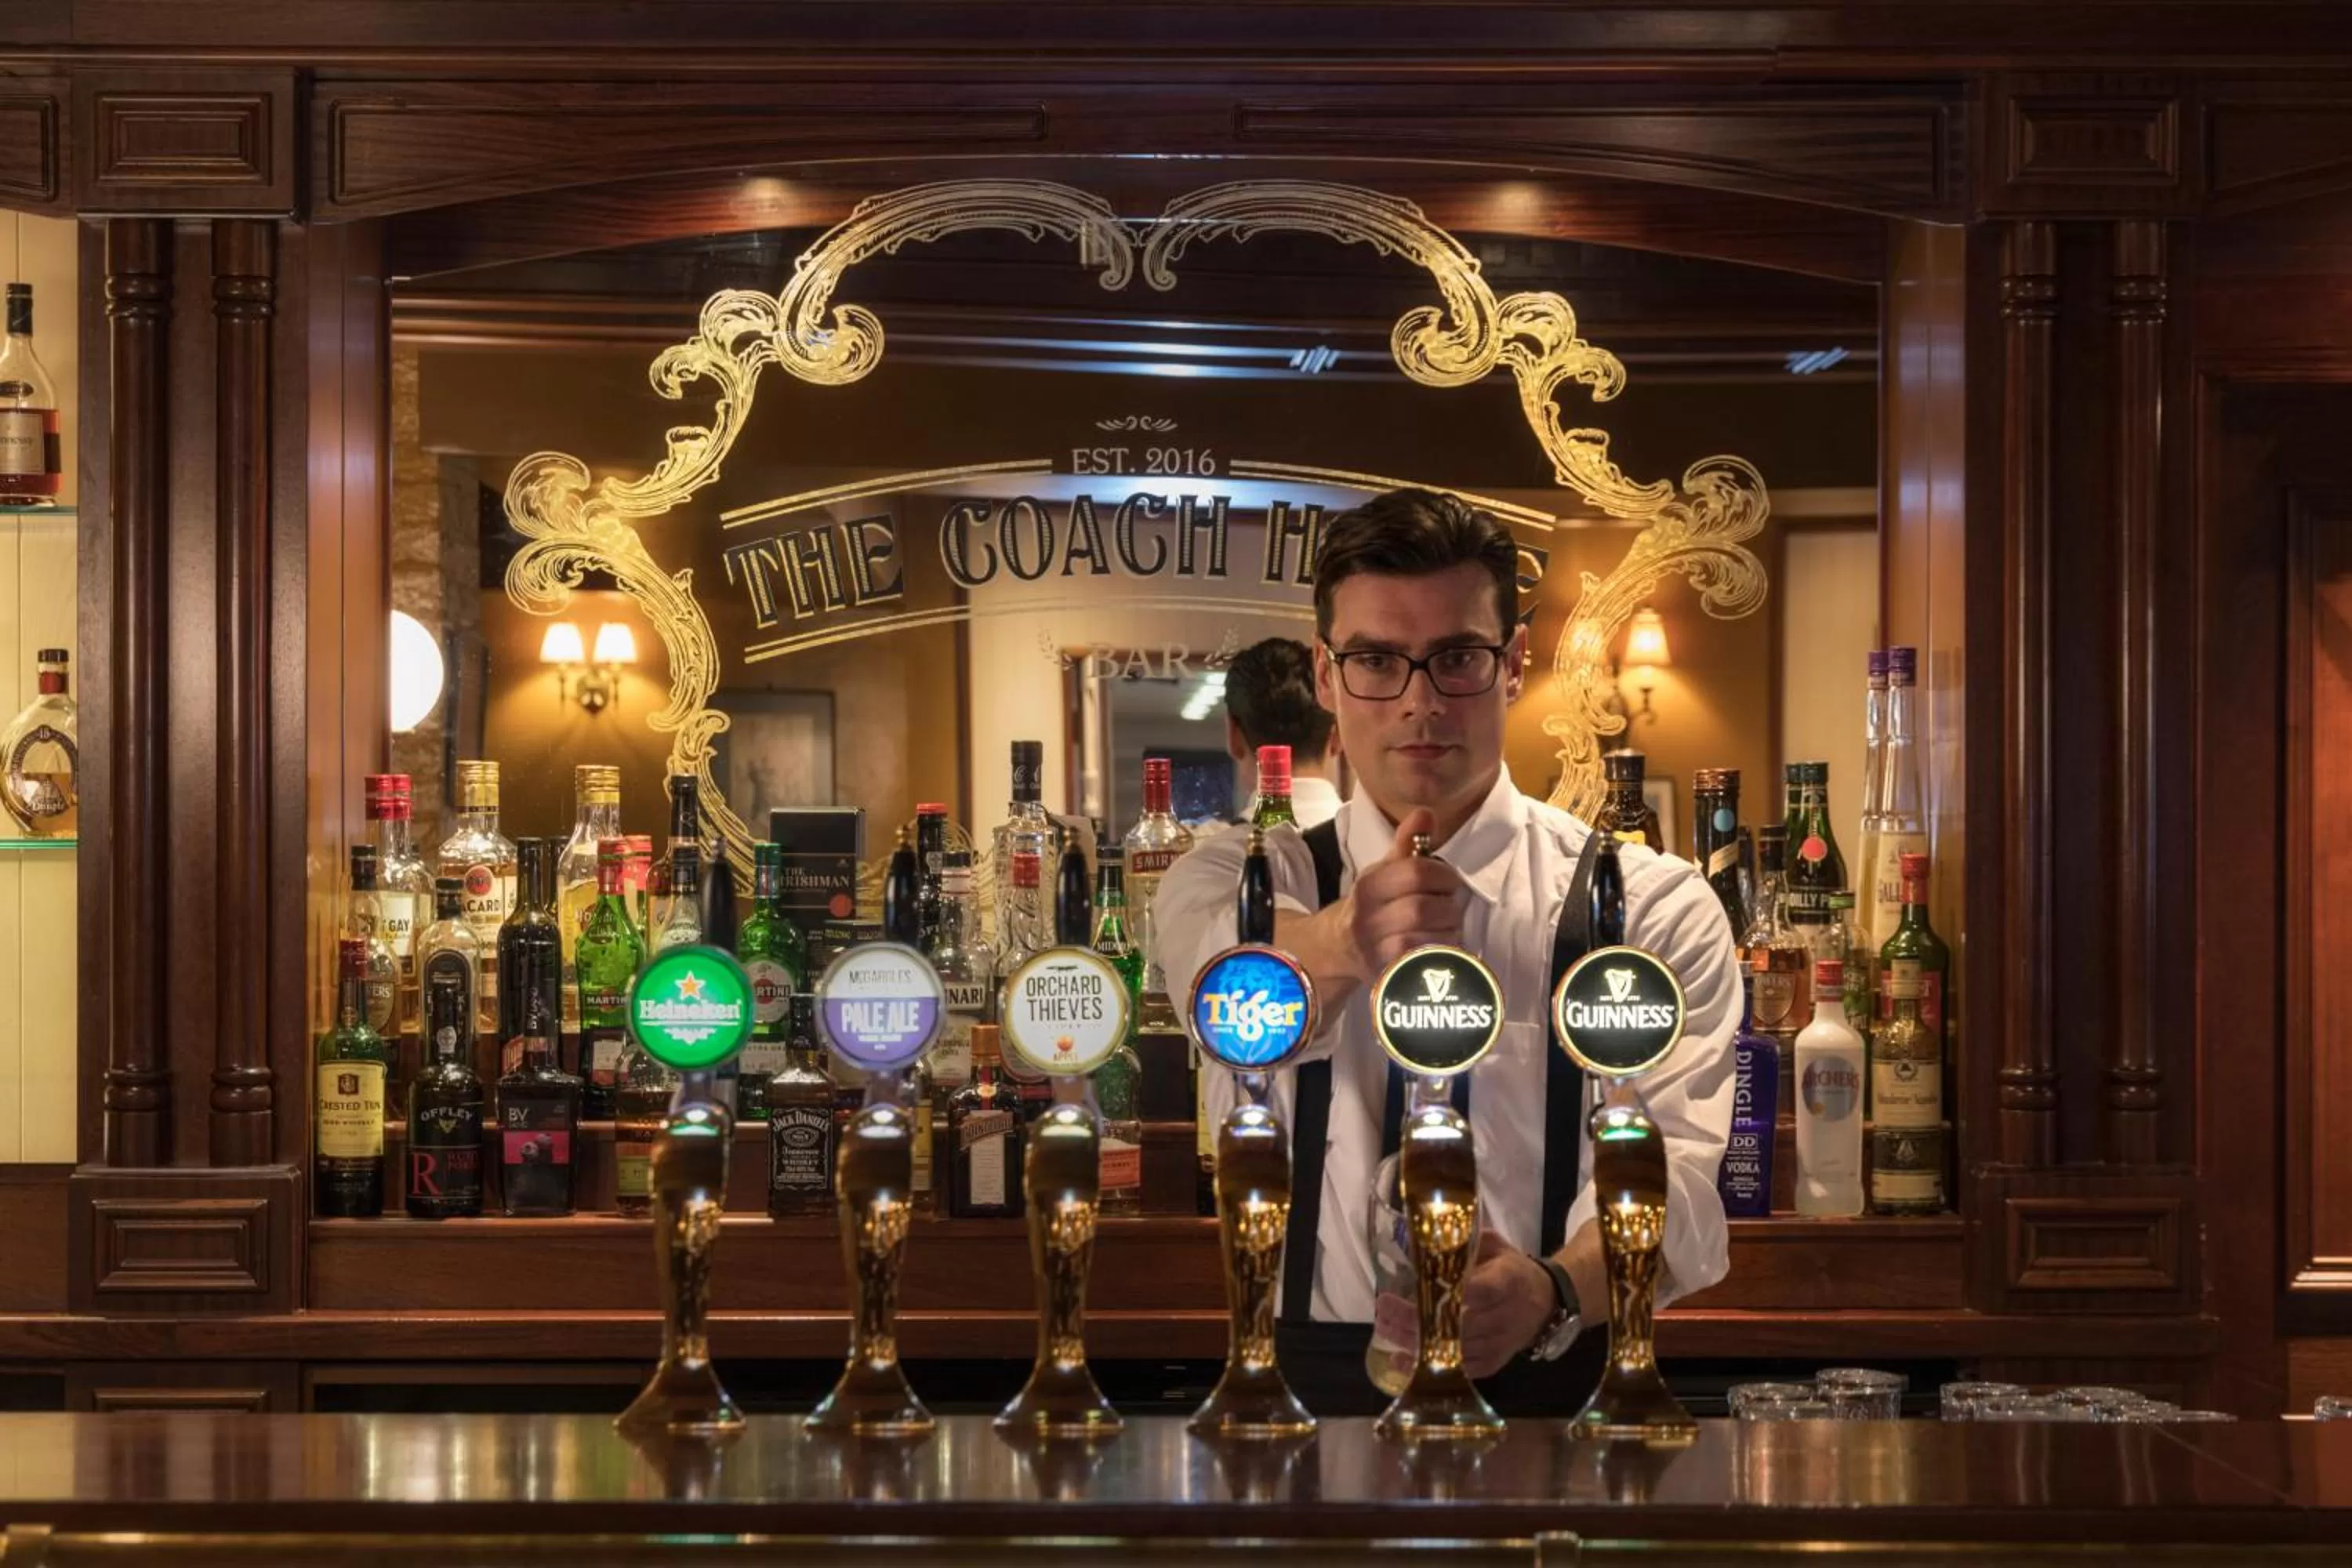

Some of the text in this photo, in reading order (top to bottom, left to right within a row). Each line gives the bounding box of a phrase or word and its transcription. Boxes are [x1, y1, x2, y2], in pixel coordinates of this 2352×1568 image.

[1072, 447, 1216, 475] EST. 2016
[724, 513, 903, 628] THE
[941, 492, 1232, 589] COACH
[1090, 641, 1198, 680] BAR
[781, 876, 850, 887] IRISHMAN
[388, 918, 410, 932] GAY
[1025, 975, 1102, 997] ORCHARD
[639, 998, 741, 1019] Heineken
[841, 1001, 920, 1033] PALE ALE
[1027, 996, 1102, 1022] THIEVES
[1203, 989, 1304, 1041] Tiger
[1384, 1001, 1493, 1029] GUINNESS
[1566, 1001, 1675, 1029] GUINNESS
[1735, 1051, 1752, 1127] DINGLE
[1733, 1137, 1756, 1147] DD
[410, 1152, 441, 1197] R
[1726, 1162, 1760, 1174] VODKA
